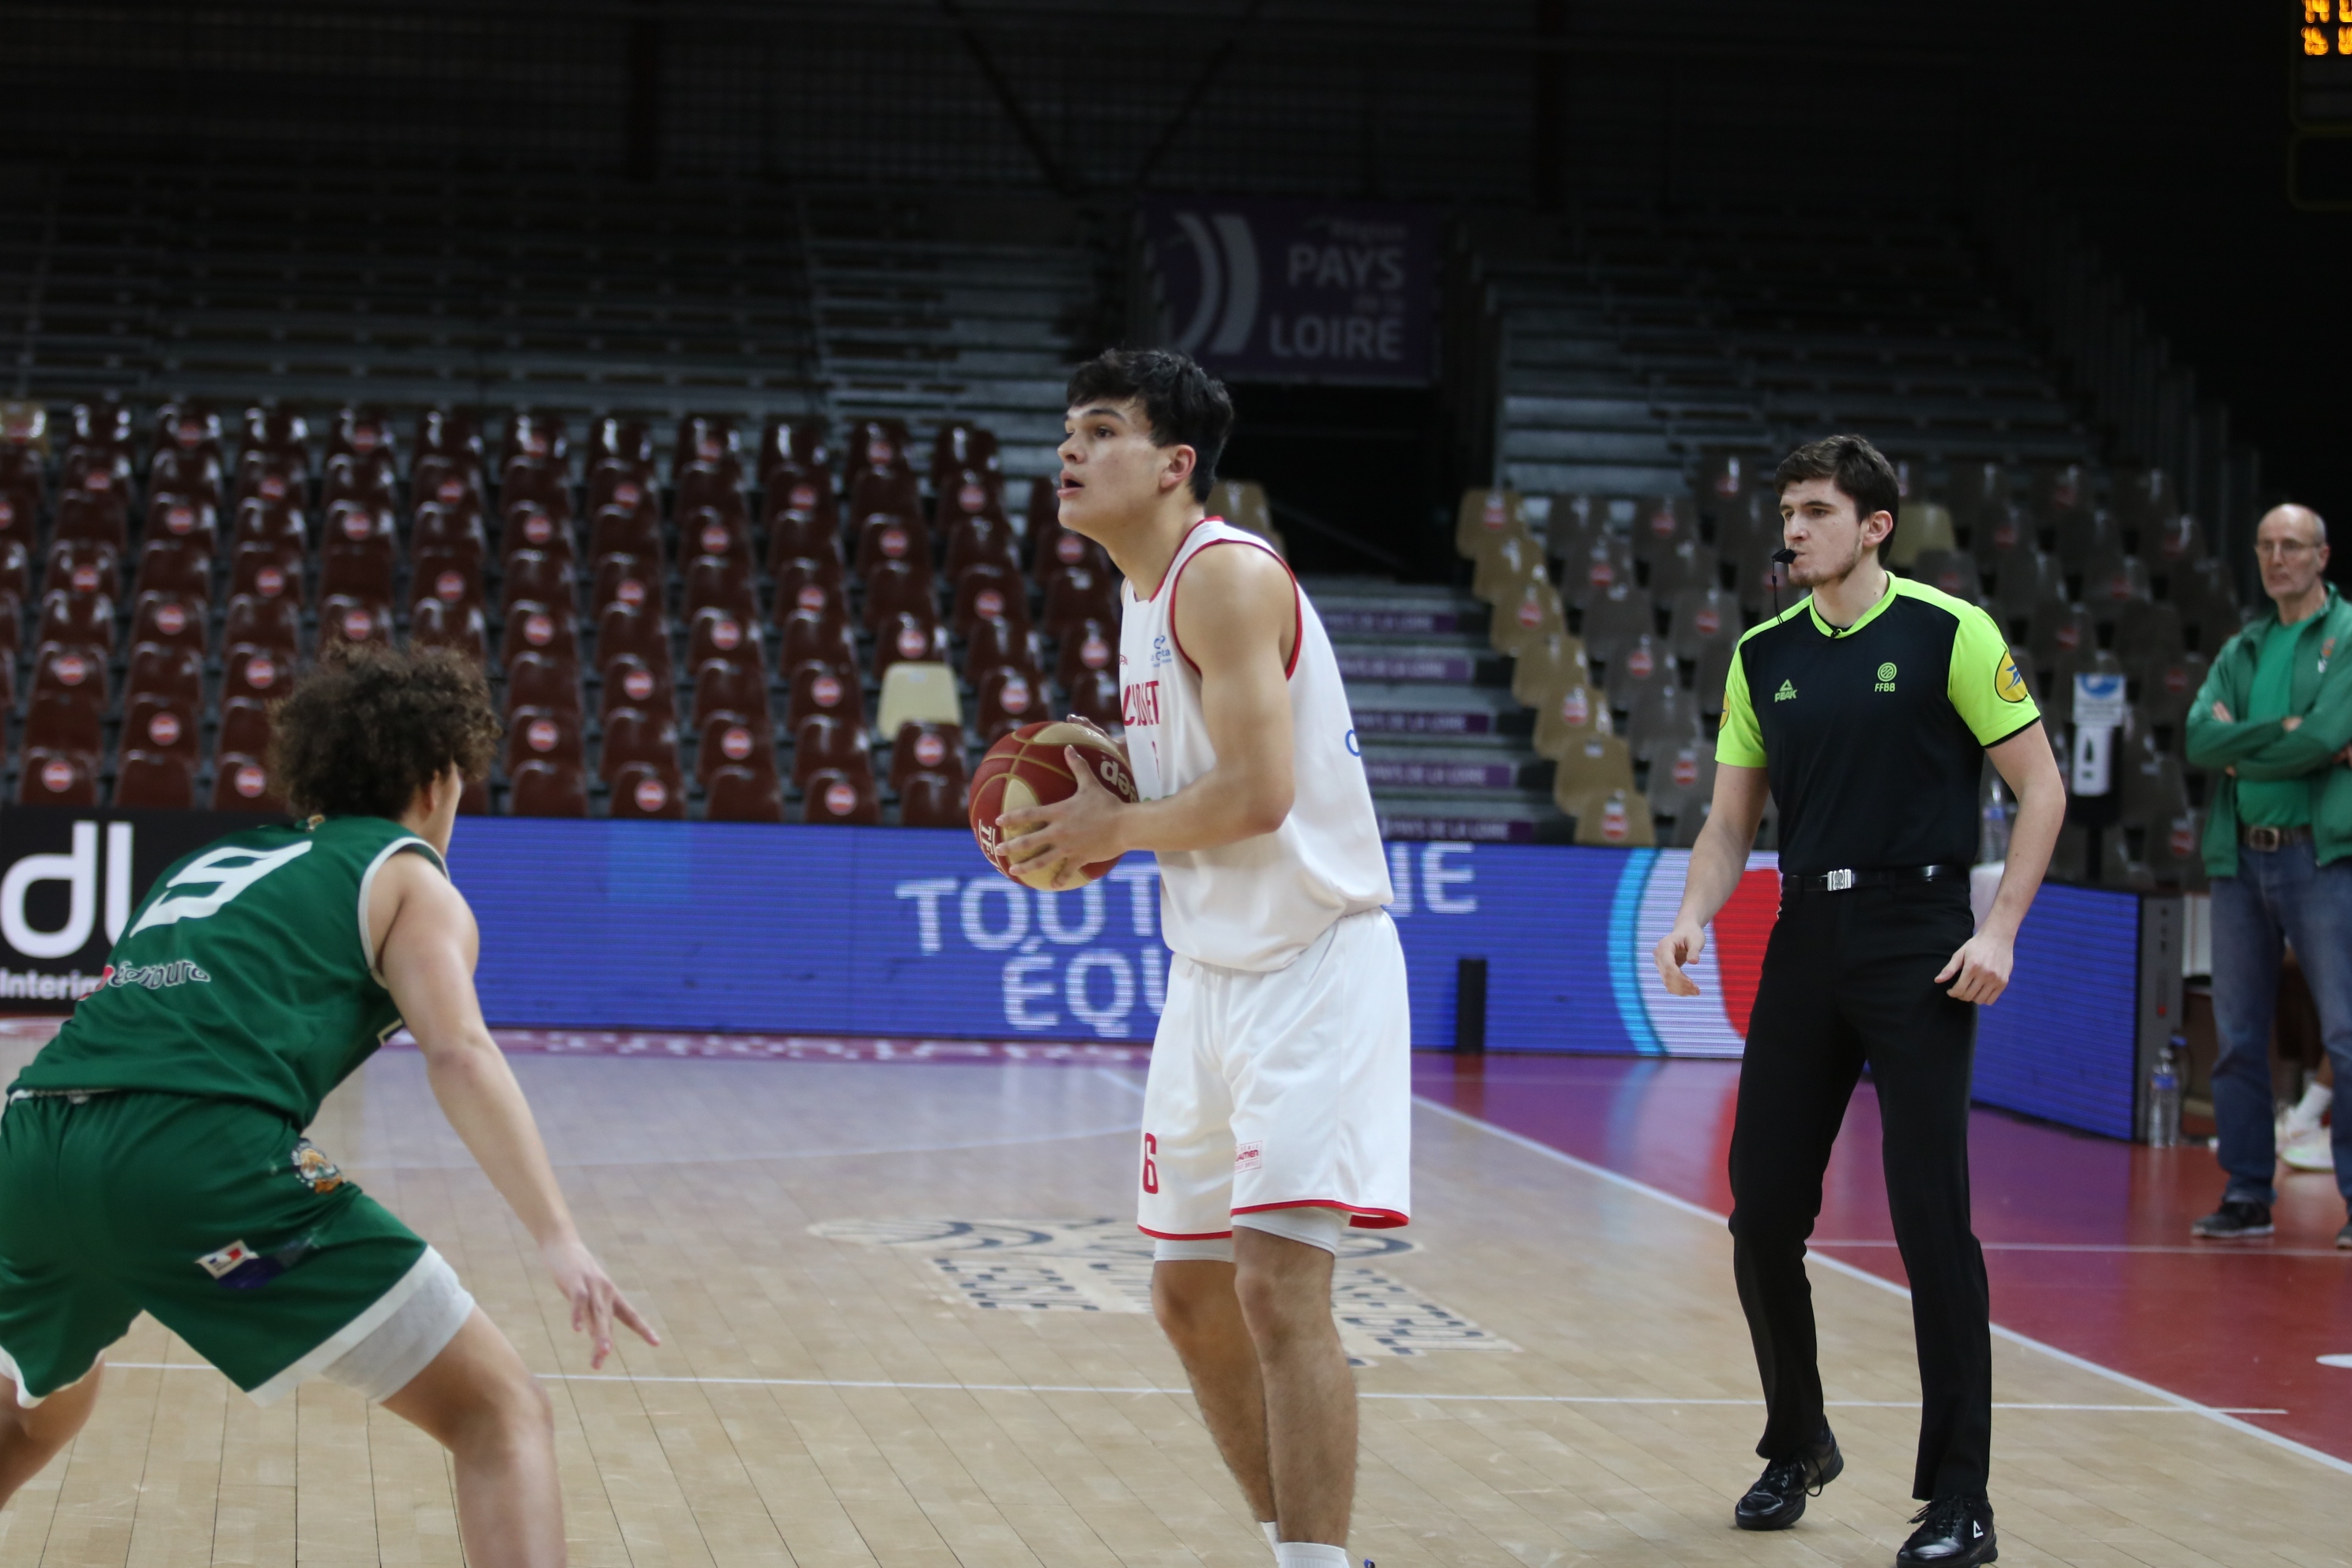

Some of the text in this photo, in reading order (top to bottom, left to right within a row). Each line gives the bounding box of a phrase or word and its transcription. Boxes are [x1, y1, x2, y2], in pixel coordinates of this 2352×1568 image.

[1287, 243, 1404, 291] PAYS
[1268, 315, 1404, 360] LOIRE
[1774, 689, 1797, 703] PEAK
[1874, 683, 1895, 692] FFBB
[129, 840, 313, 939] 9
[1143, 1132, 1159, 1195] 6
